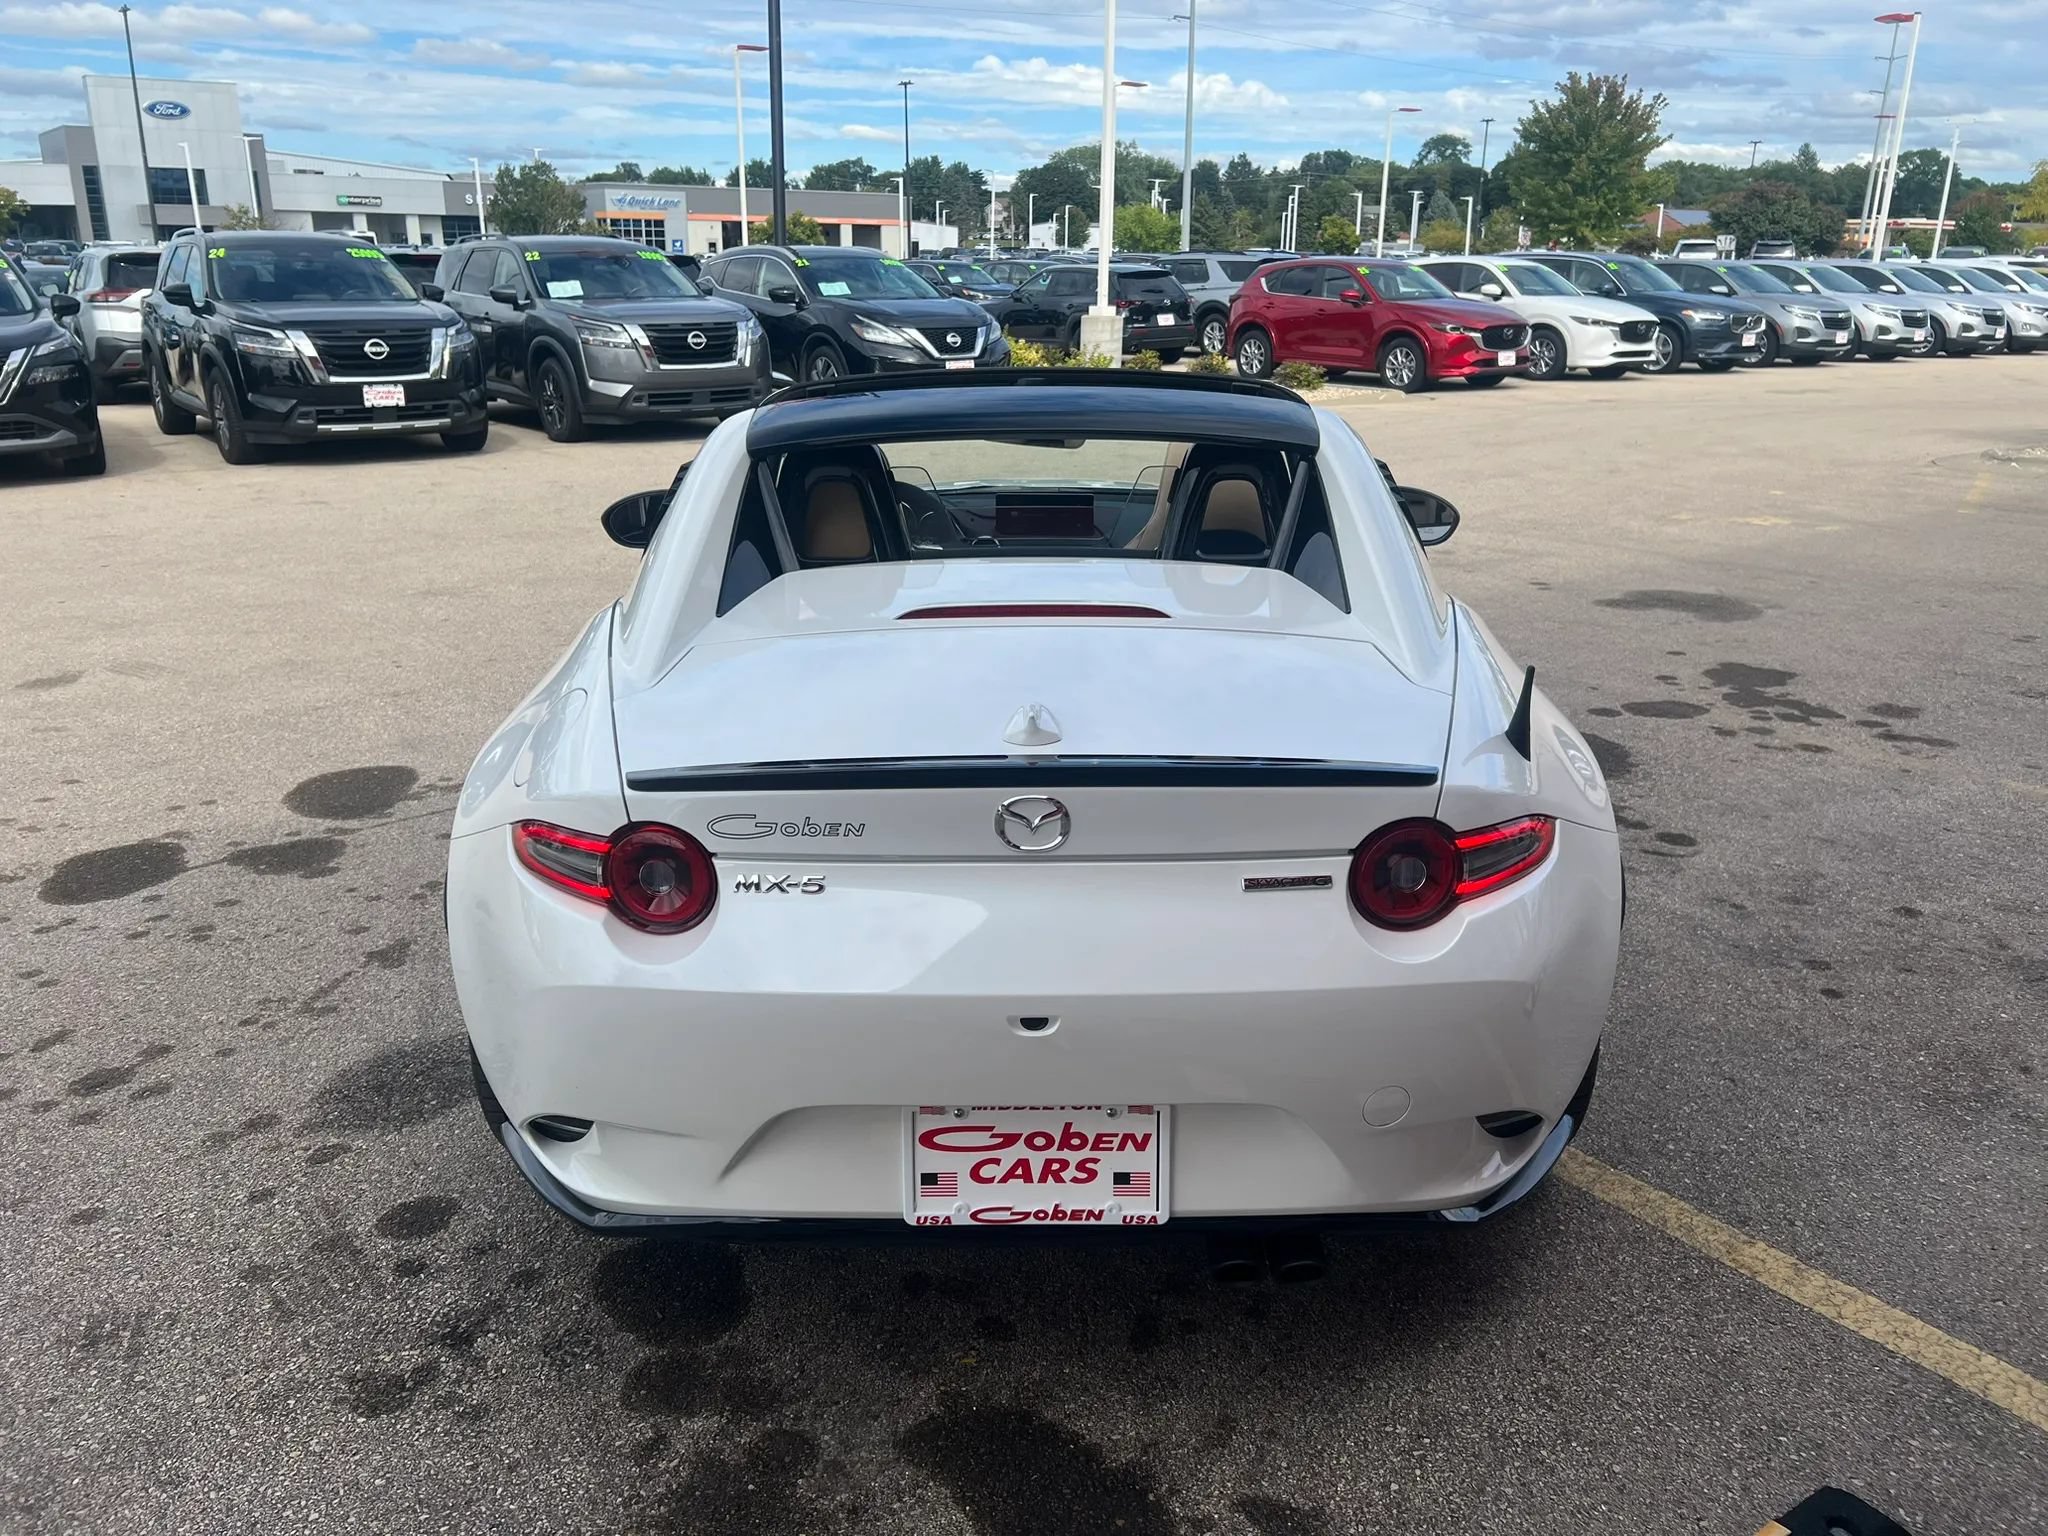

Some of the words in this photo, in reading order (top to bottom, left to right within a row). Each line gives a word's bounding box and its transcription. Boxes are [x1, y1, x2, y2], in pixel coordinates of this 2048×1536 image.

[153, 103, 181, 115] Ford
[627, 196, 656, 208] Quick
[657, 198, 681, 209] Lane
[207, 247, 226, 259] 24
[524, 251, 541, 262] 22
[733, 873, 827, 896] MX-5
[969, 1156, 1101, 1185] CARS
[915, 1215, 953, 1226] USA
[1121, 1214, 1159, 1225] USA
